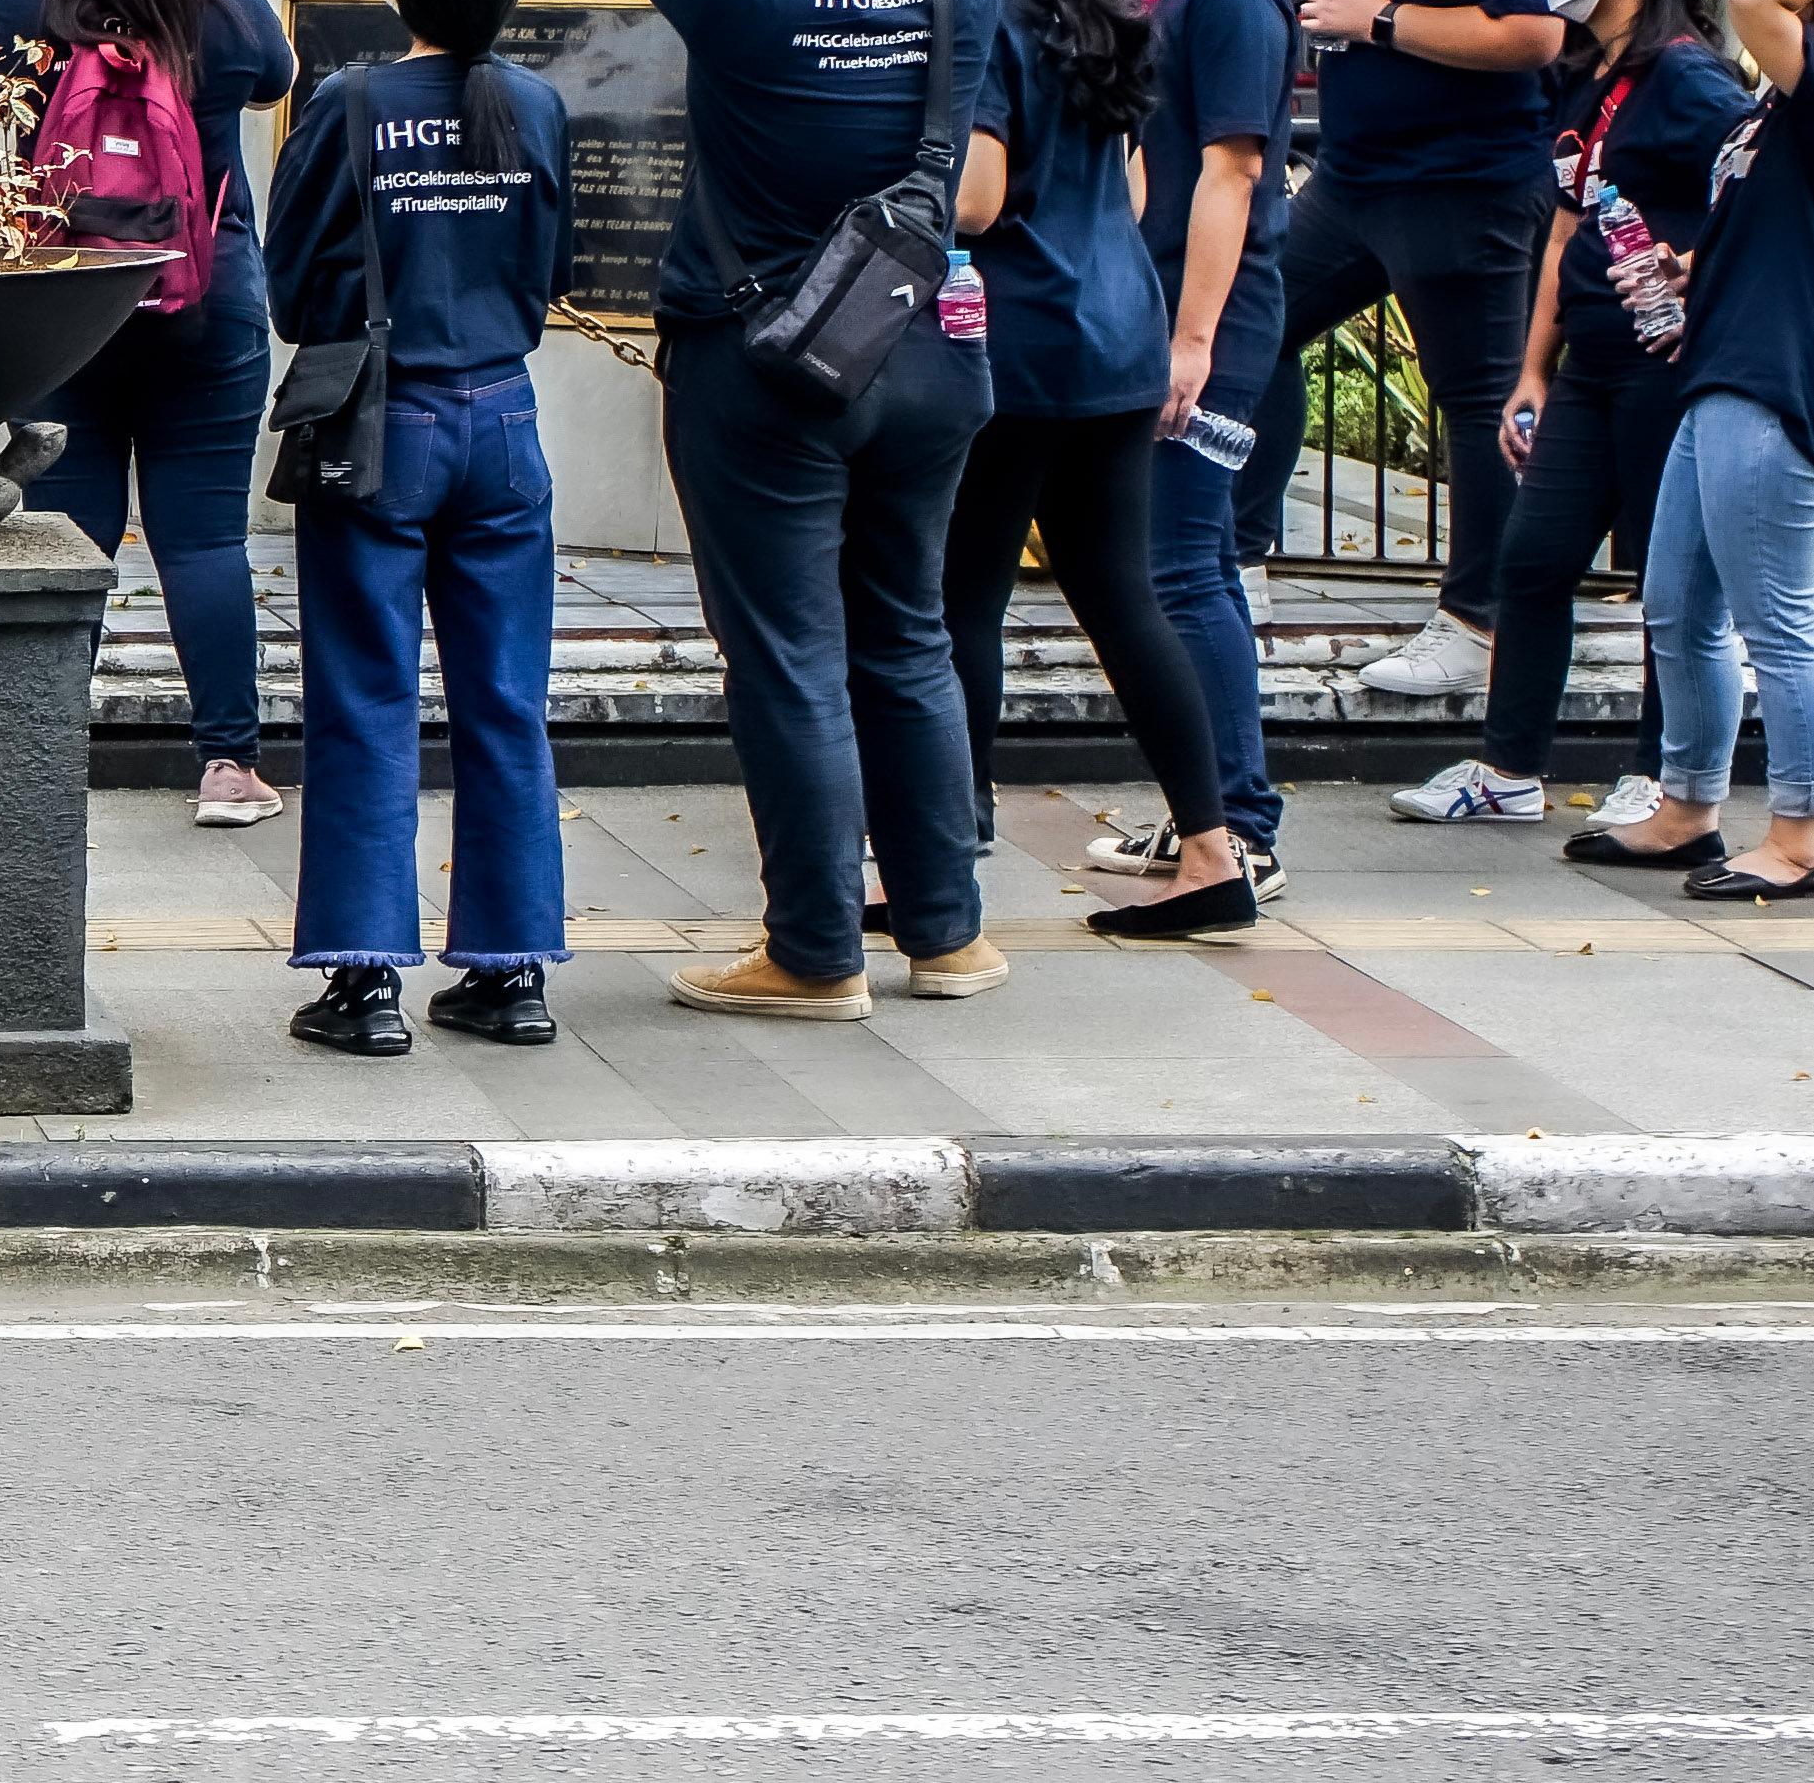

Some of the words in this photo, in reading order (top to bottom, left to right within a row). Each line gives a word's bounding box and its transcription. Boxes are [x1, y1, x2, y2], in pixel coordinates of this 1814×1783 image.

[792, 29, 933, 48] #IHGCelebrateServic
[818, 50, 928, 70] #TrueHospitality
[375, 118, 441, 151] IHG
[390, 193, 509, 214] #TrueHospitality
